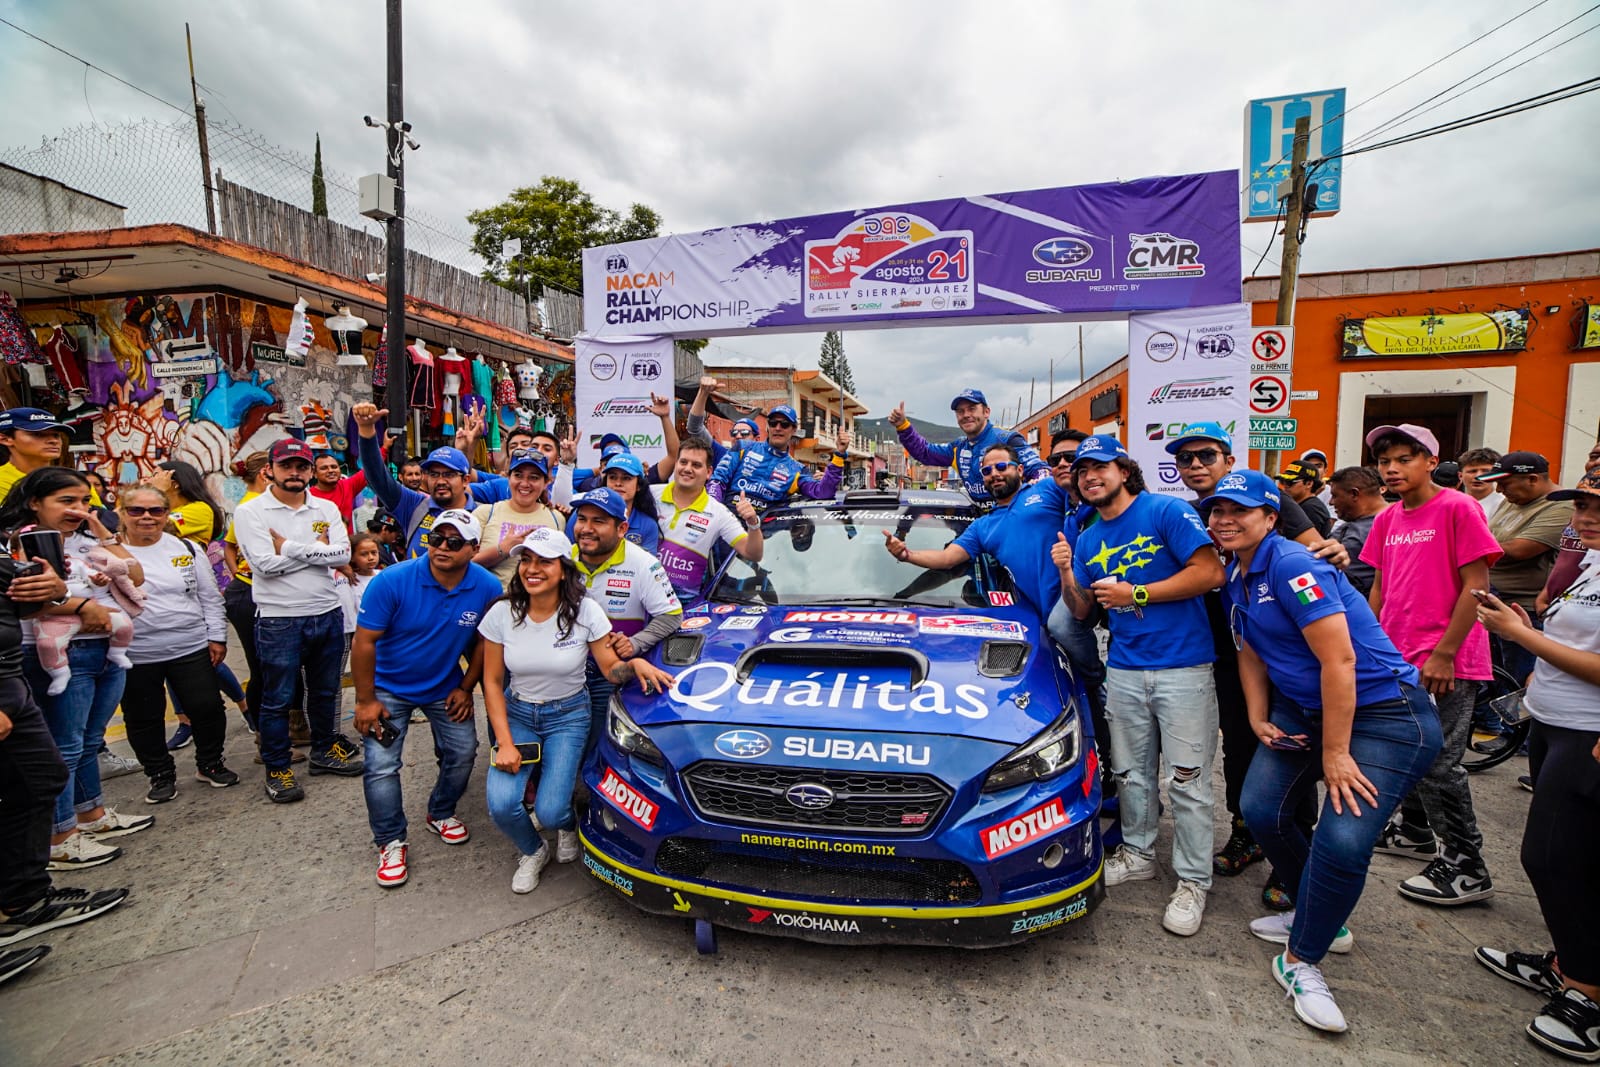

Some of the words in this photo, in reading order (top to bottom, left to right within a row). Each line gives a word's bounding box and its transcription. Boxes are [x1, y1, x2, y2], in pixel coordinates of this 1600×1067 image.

[1129, 244, 1200, 269] CMR
[876, 264, 924, 280] agosto
[1026, 269, 1101, 282] SUBARU
[606, 271, 674, 291] NACAM
[606, 289, 662, 308] RALLY
[809, 291, 848, 301] RALLY
[857, 287, 907, 298] SIERRA
[915, 284, 968, 295] JUÁREZ
[605, 300, 750, 325] CHAMPIONSHIP
[157, 367, 171, 375] CALLE
[1168, 386, 1234, 399] FEMADAC
[1269, 437, 1275, 447] EL
[1276, 437, 1293, 447] AGUA
[822, 511, 849, 521] Tim
[1385, 533, 1411, 546] LUMA
[989, 592, 1014, 606] OK
[785, 612, 915, 624] MOTUL
[825, 629, 905, 639] Guanajuato
[553, 640, 578, 648] SUBARU
[669, 662, 989, 719] Quálitas
[783, 736, 930, 766] SUBARU
[601, 773, 653, 825] MOTUL
[989, 803, 1064, 854] MOTUL
[584, 853, 613, 880] EXTREME
[613, 873, 633, 890] TOYS
[773, 912, 860, 933] YOKOHAMA
[1012, 908, 1065, 931] EXTREME
[1065, 897, 1087, 916] TOYS
